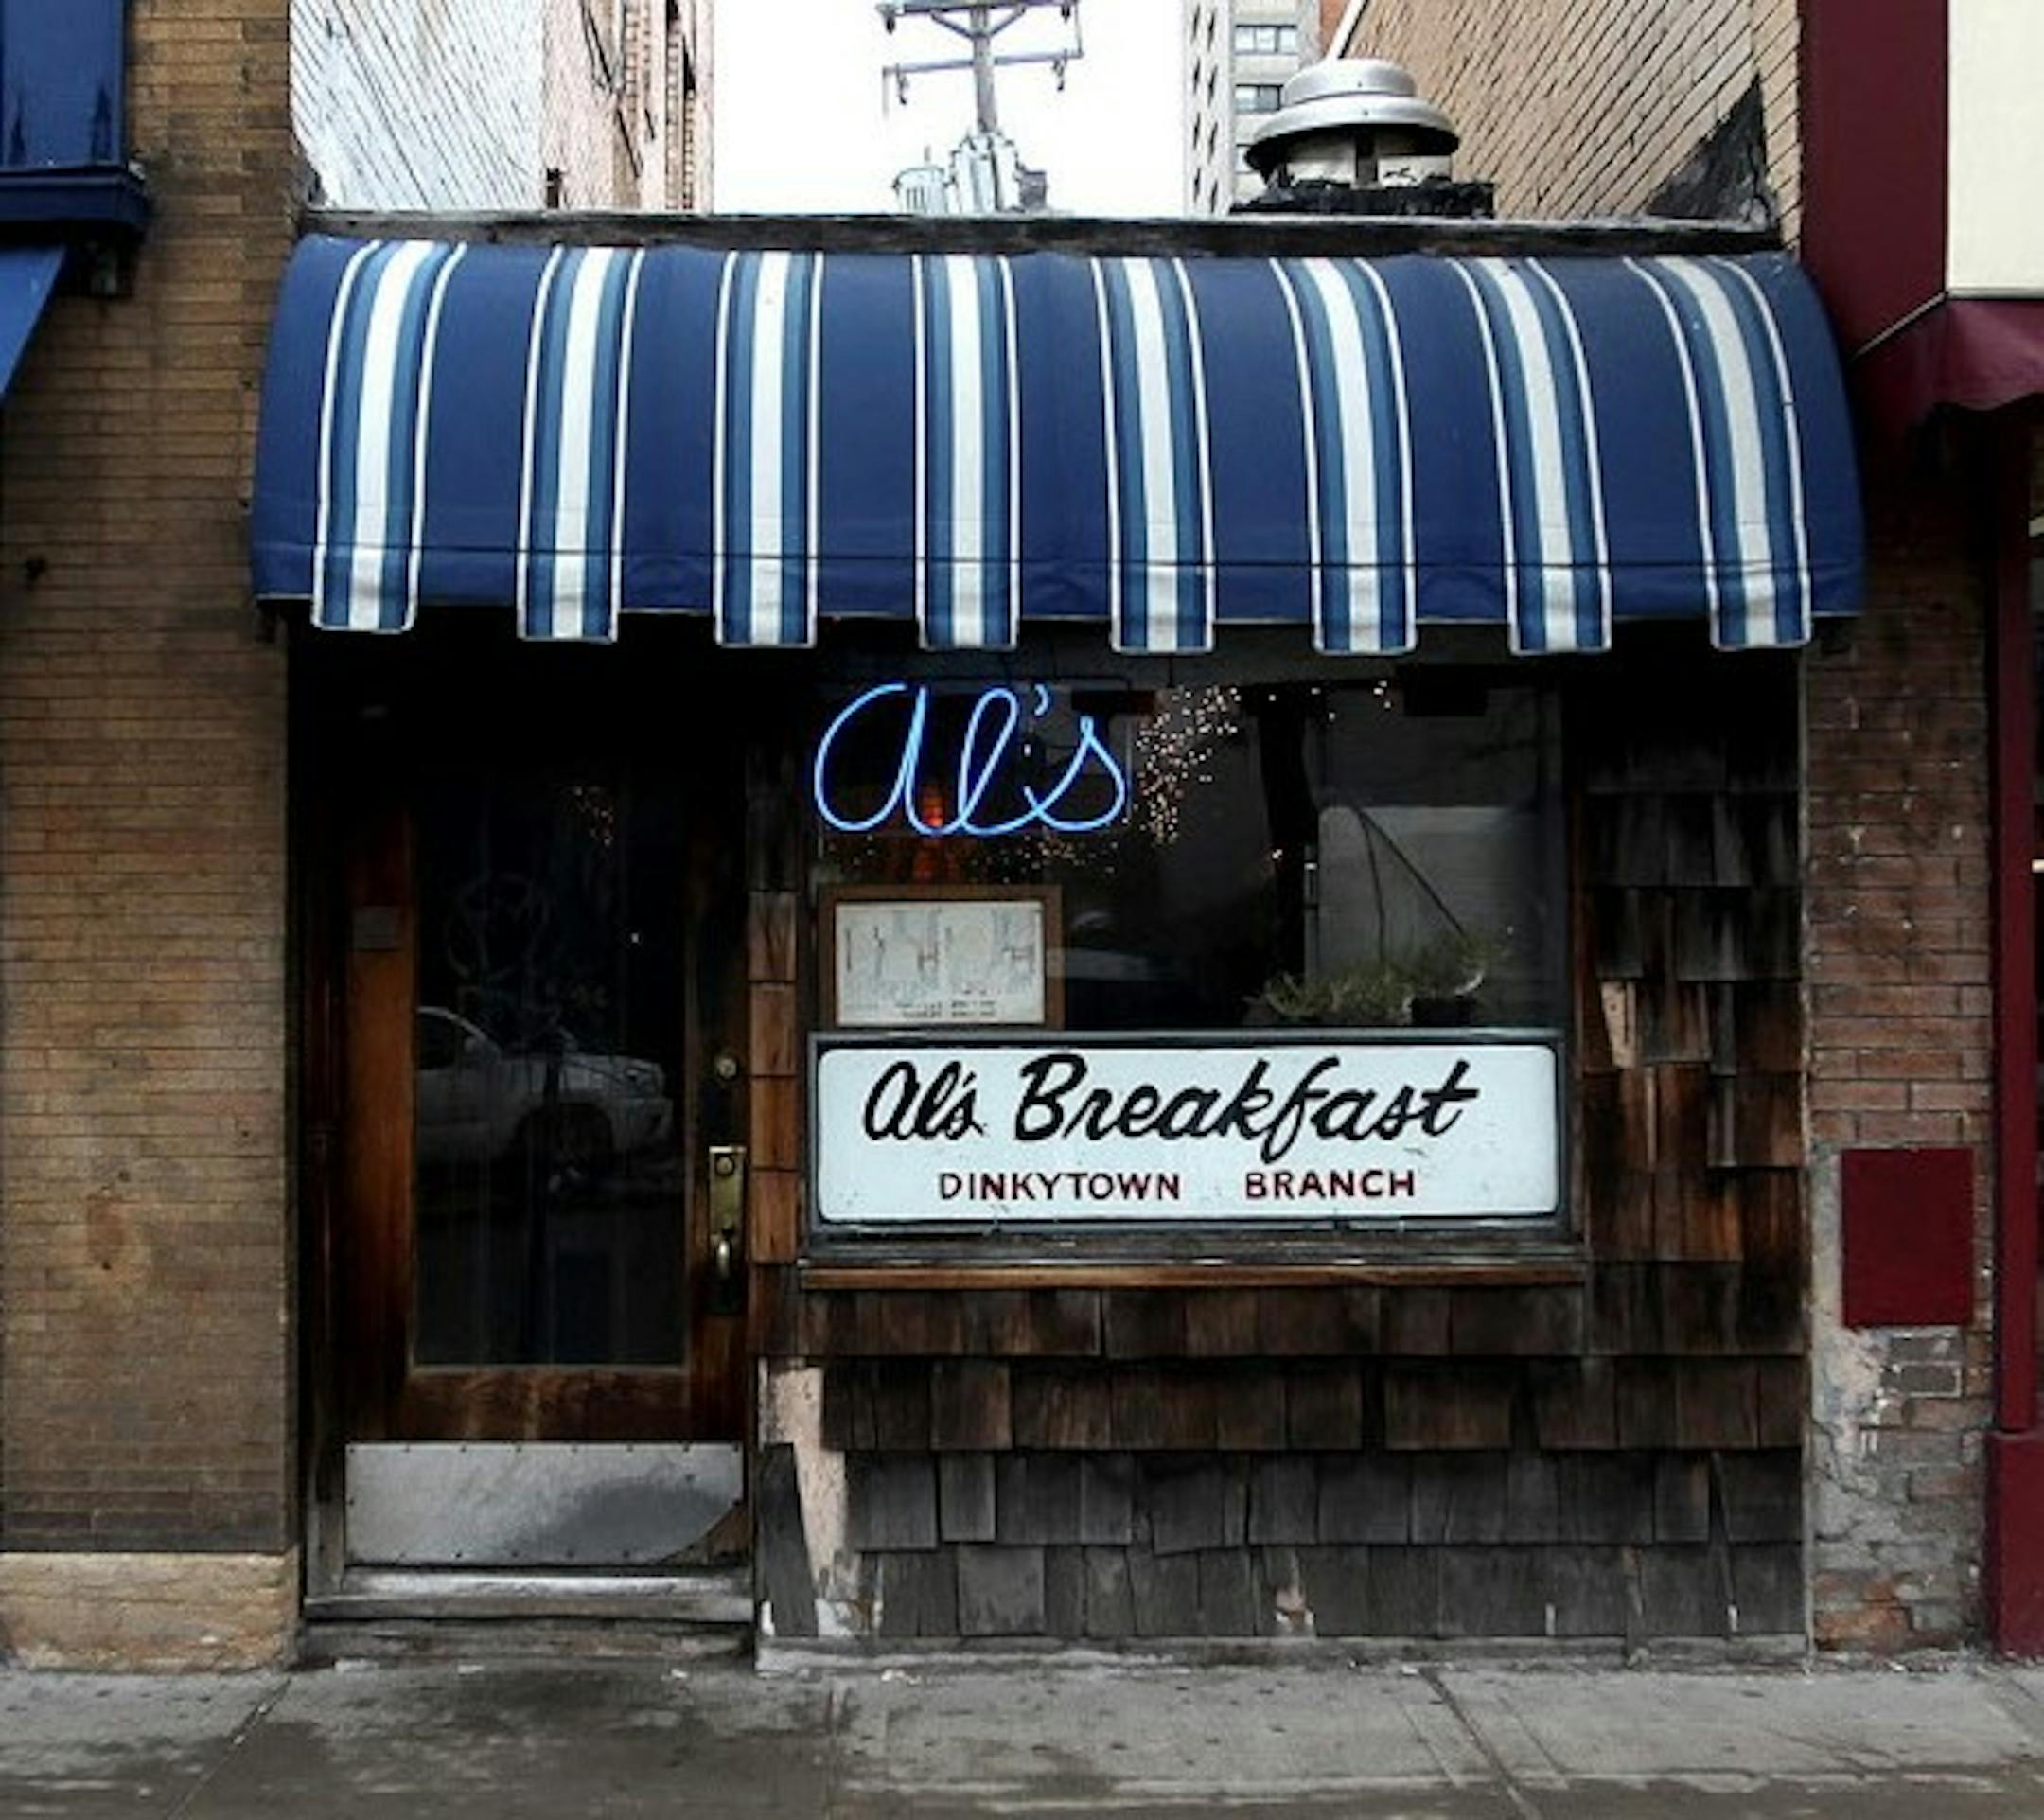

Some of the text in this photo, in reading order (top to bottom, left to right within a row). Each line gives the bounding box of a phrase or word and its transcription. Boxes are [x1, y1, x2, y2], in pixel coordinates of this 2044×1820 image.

[864, 1053, 1479, 1164] Al's Breakfast
[939, 1170, 1416, 1201] DINKYTOWN BRANCH
